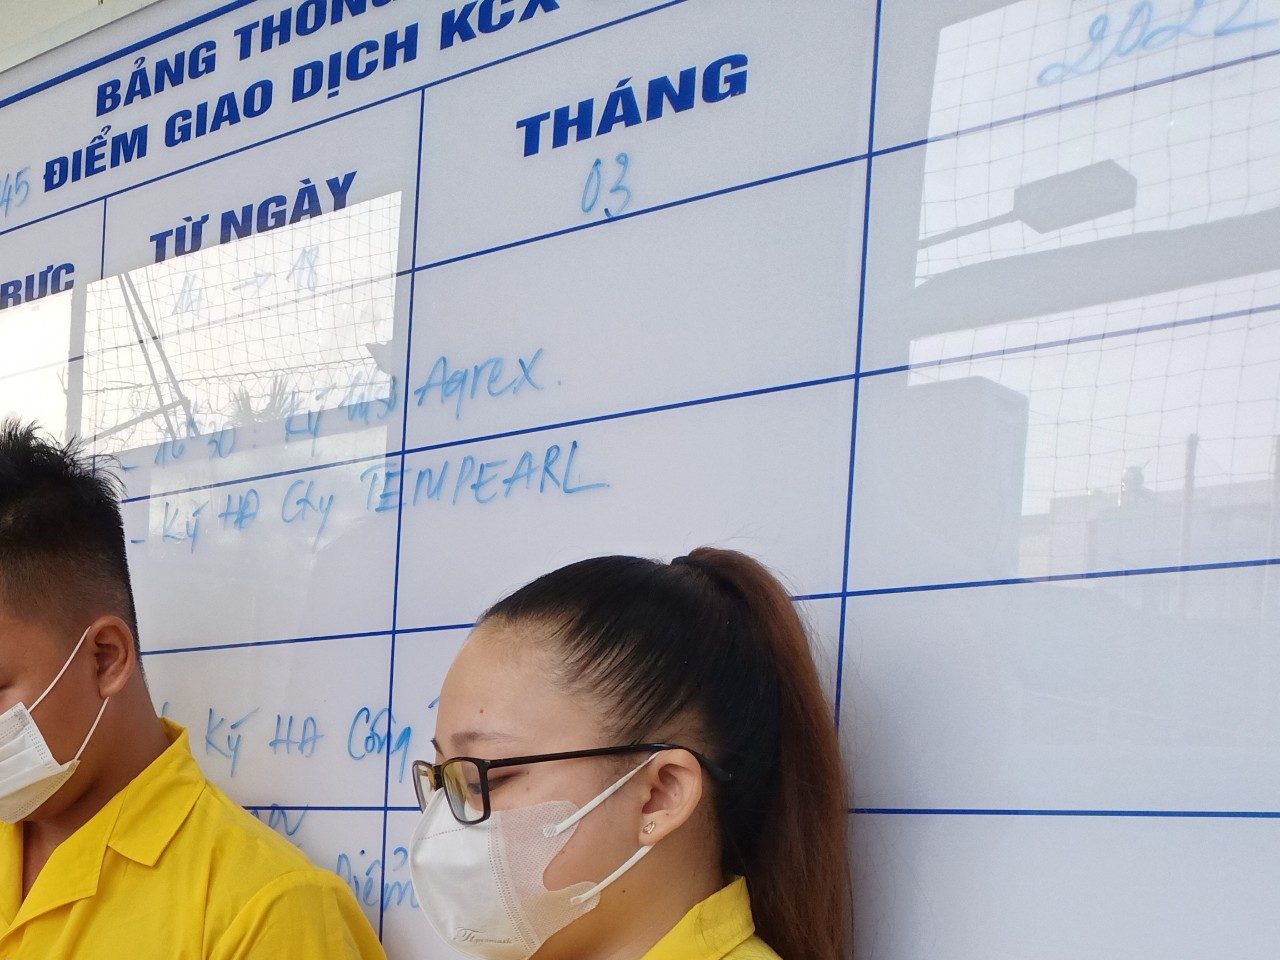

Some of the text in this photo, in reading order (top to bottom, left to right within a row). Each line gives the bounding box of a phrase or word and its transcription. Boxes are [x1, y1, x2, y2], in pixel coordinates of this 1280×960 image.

[43, 124, 148, 193] ĐIỂM
[165, 79, 273, 148] GIAO
[292, 22, 419, 104] DỊCH
[96, 40, 216, 117] BẢNG
[516, 53, 749, 158] THÁNG
[150, 170, 358, 264] TỪ NGÀY
[581, 152, 632, 219] 03
